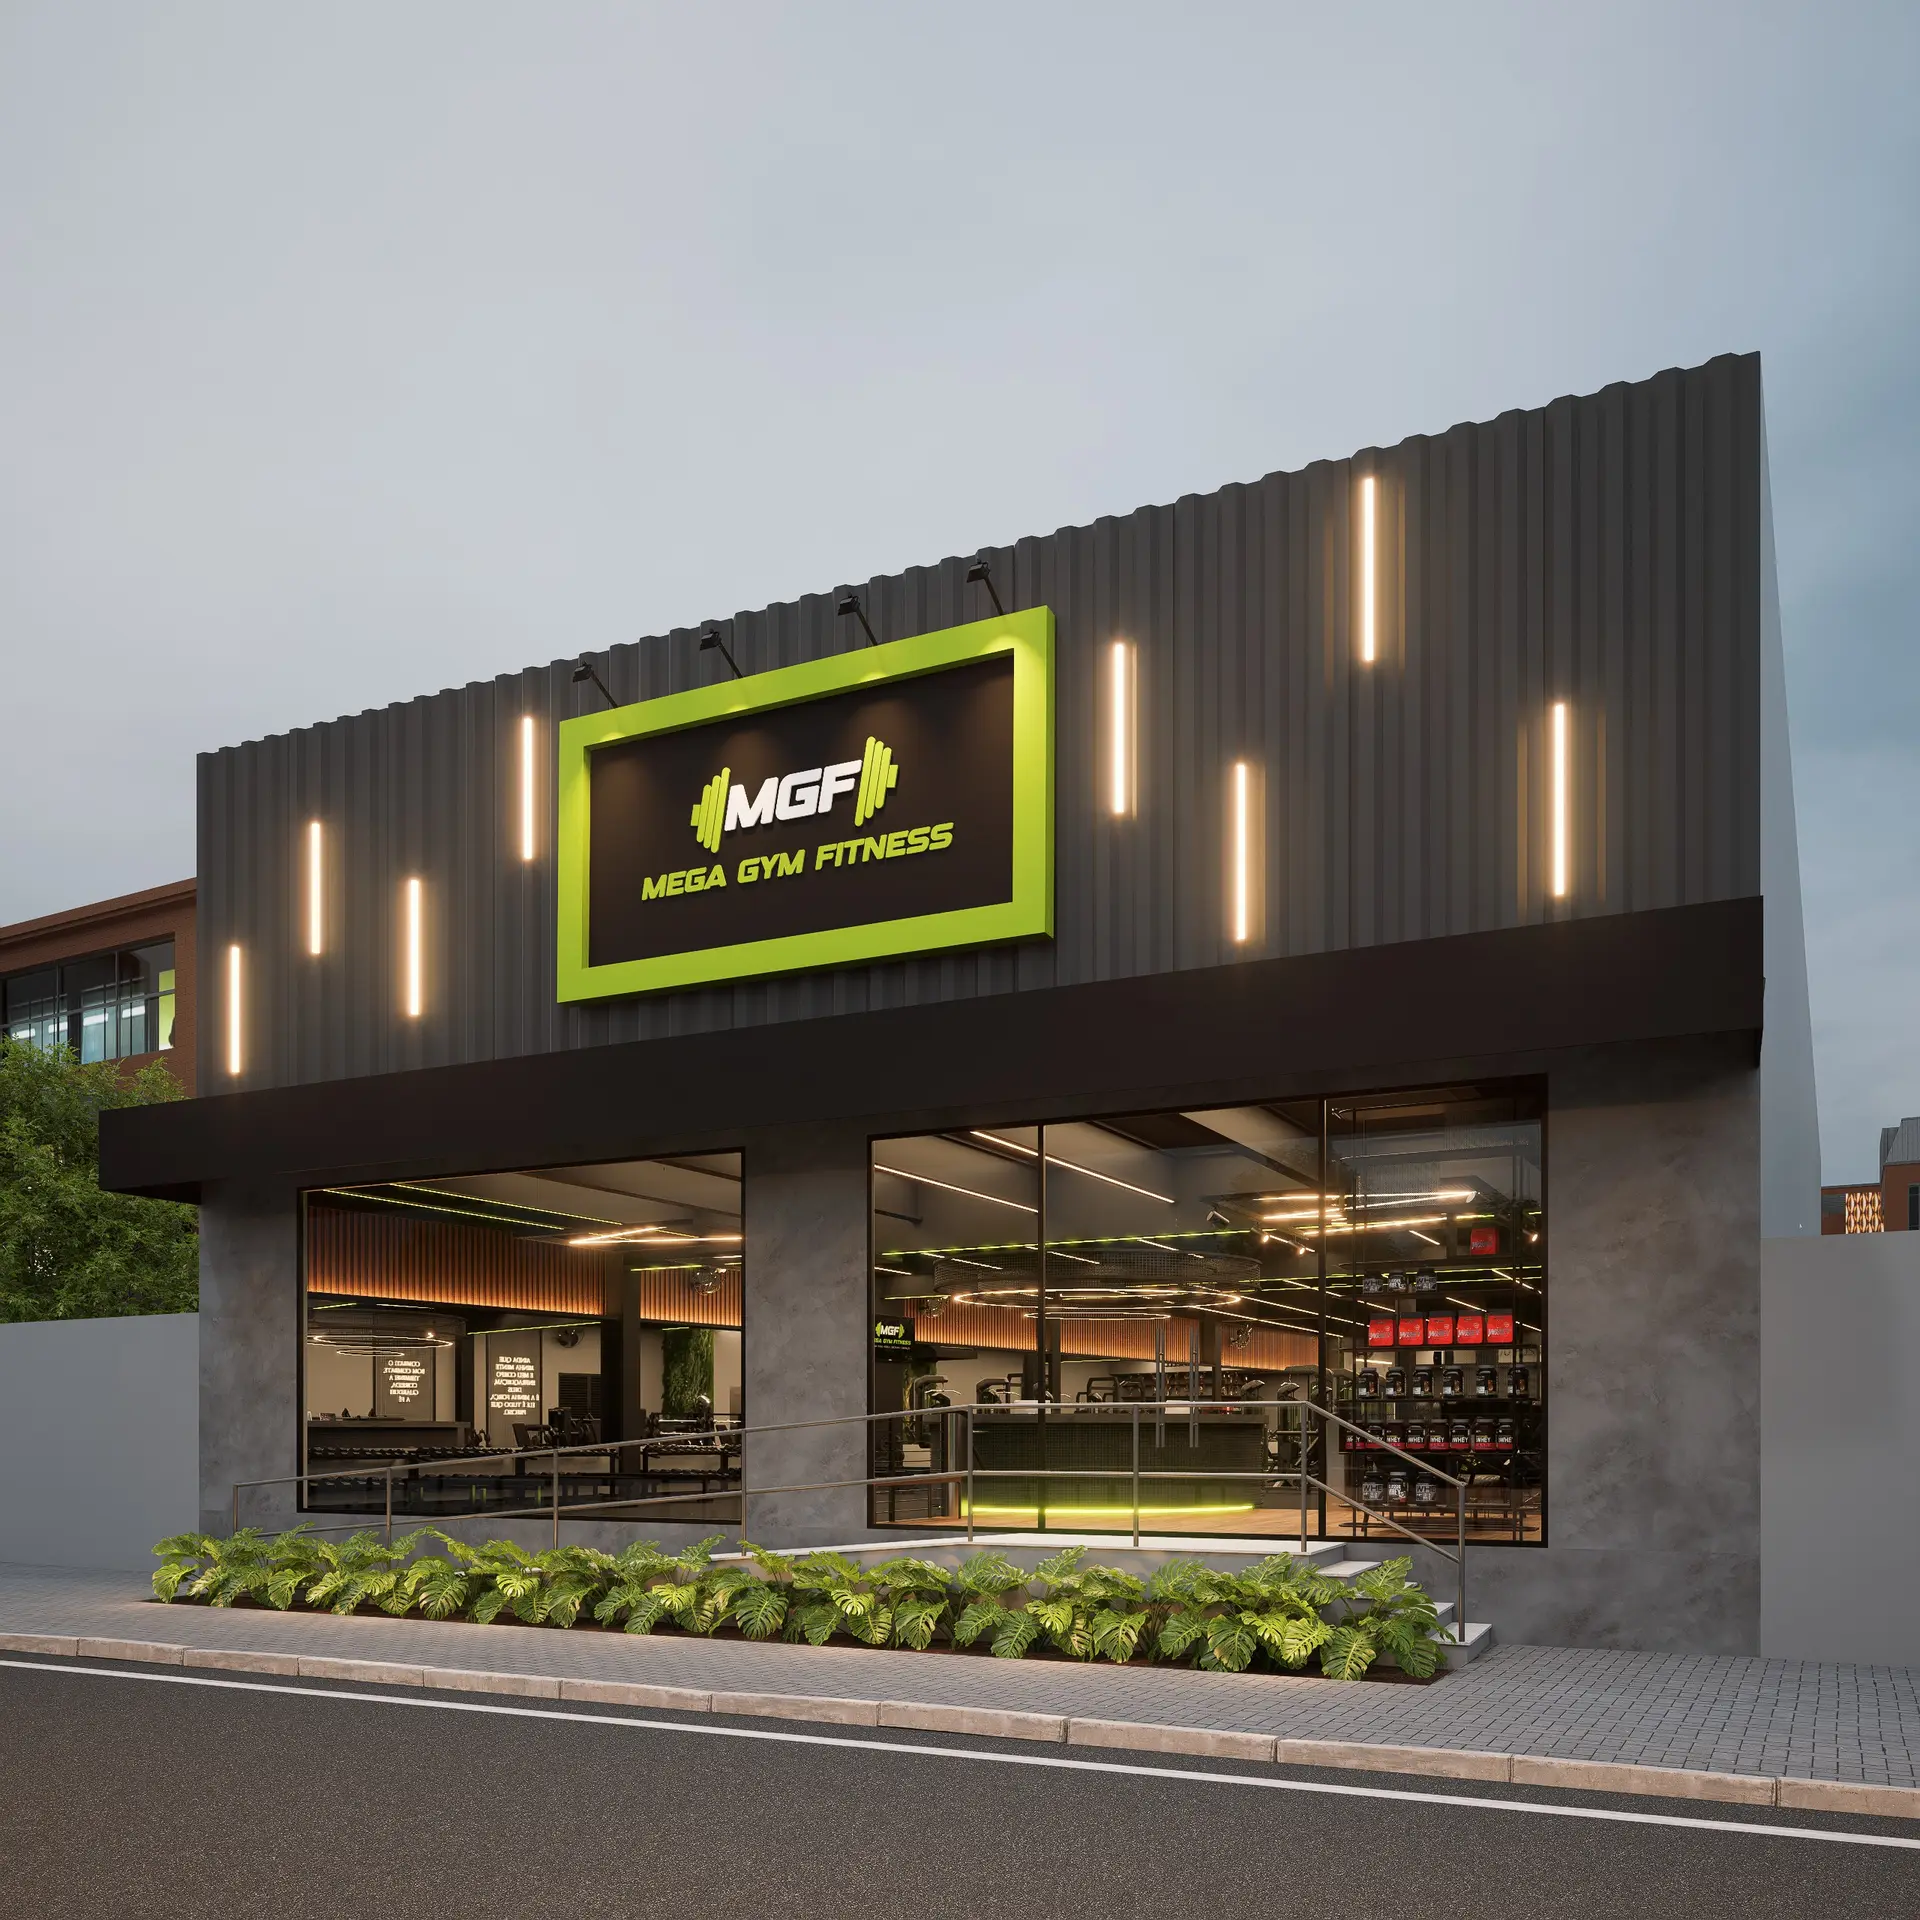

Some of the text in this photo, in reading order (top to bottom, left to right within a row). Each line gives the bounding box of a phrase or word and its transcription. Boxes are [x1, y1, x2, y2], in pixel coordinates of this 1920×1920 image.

[724, 760, 862, 832] MGF
[641, 822, 954, 901] MEGA GYM FITNESS
[881, 1325, 900, 1335] MGF
